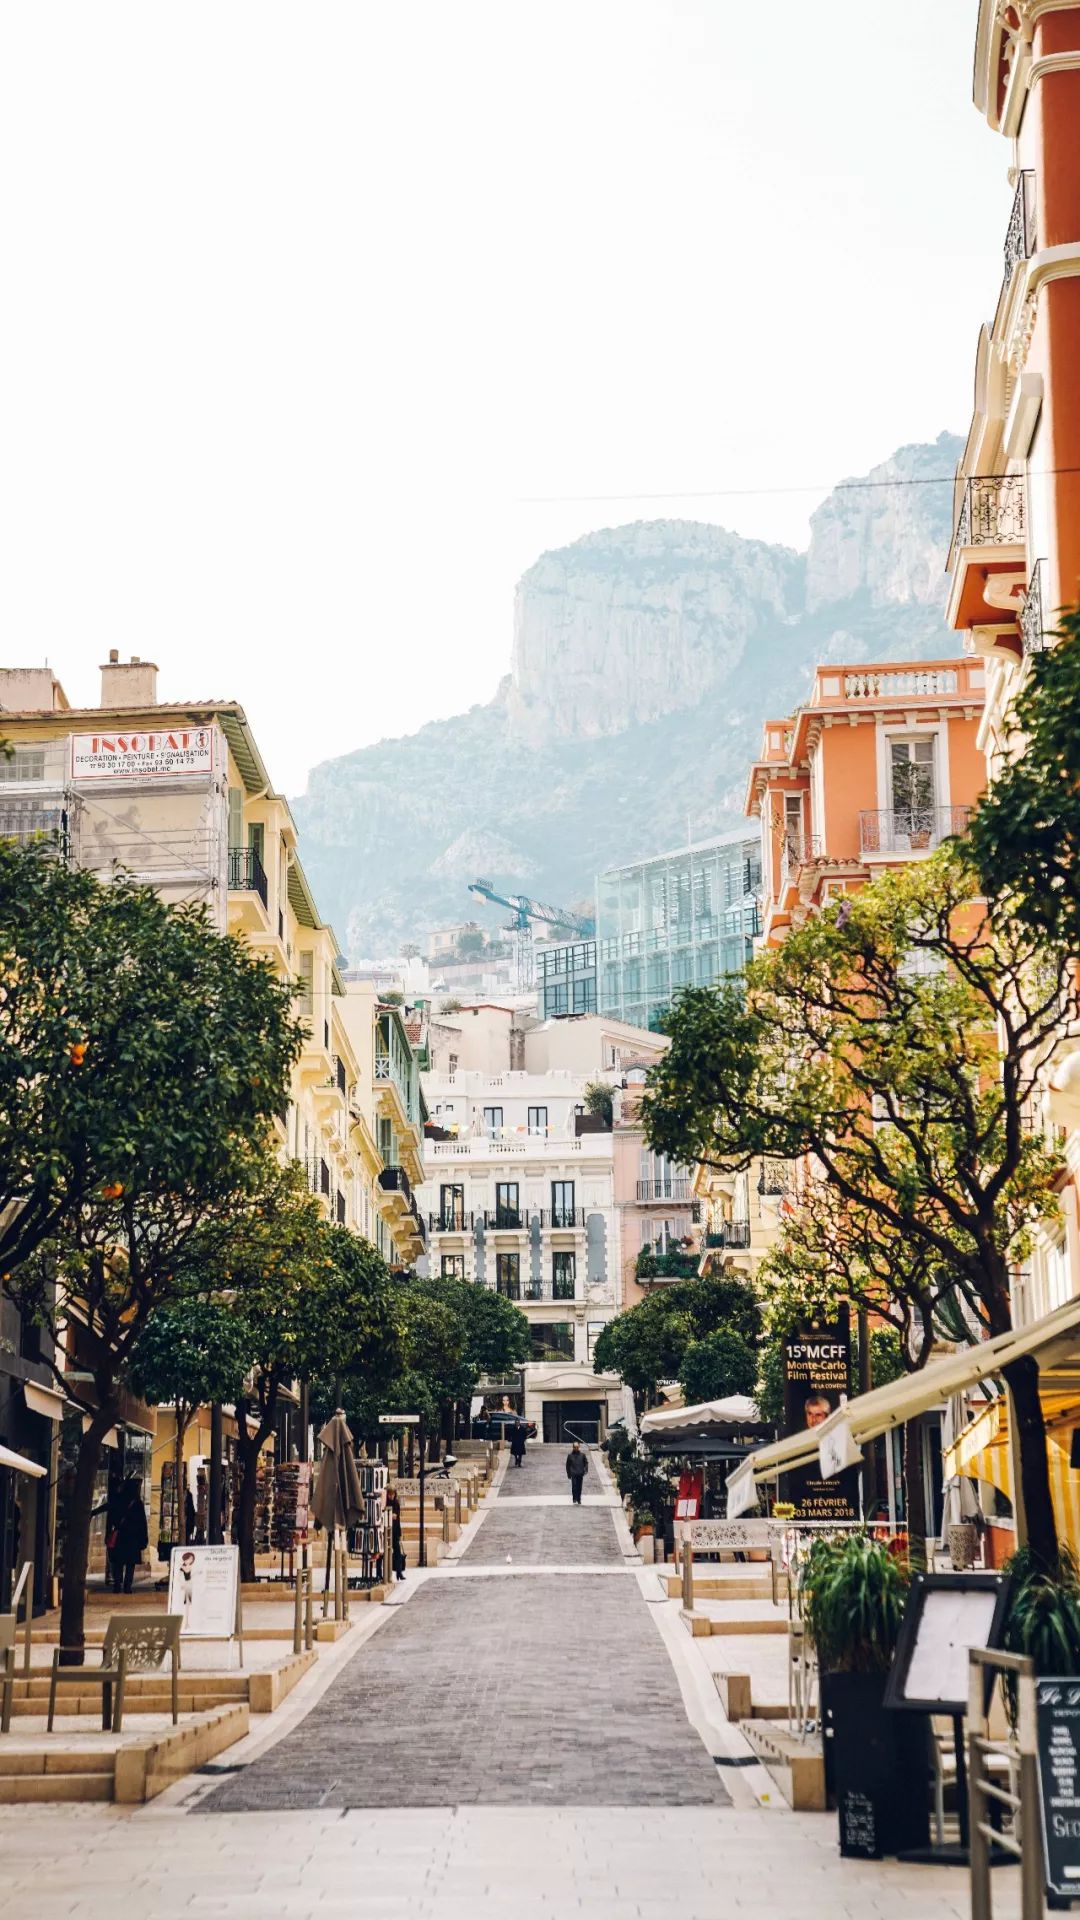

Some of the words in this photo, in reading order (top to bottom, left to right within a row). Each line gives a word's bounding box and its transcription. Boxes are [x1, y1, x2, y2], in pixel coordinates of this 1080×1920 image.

[92, 733, 192, 753] INSOBAT
[122, 752, 154, 760] PEINTURE
[160, 749, 209, 759] SIGNALISATION
[97, 761, 105, 769] 93
[118, 760, 125, 768] 17
[113, 766, 171, 774] www.insobat.mc
[786, 1345, 847, 1359] 15°MCFF
[787, 1360, 847, 1370] Monte-Carlo
[787, 1371, 808, 1380] Film
[810, 1371, 847, 1380] Festival
[801, 1498, 812, 1508] 26
[814, 1496, 848, 1507] FÉVRIER
[796, 1509, 806, 1518] 03
[808, 1509, 833, 1517] MARS
[834, 1507, 855, 1517] 2018
